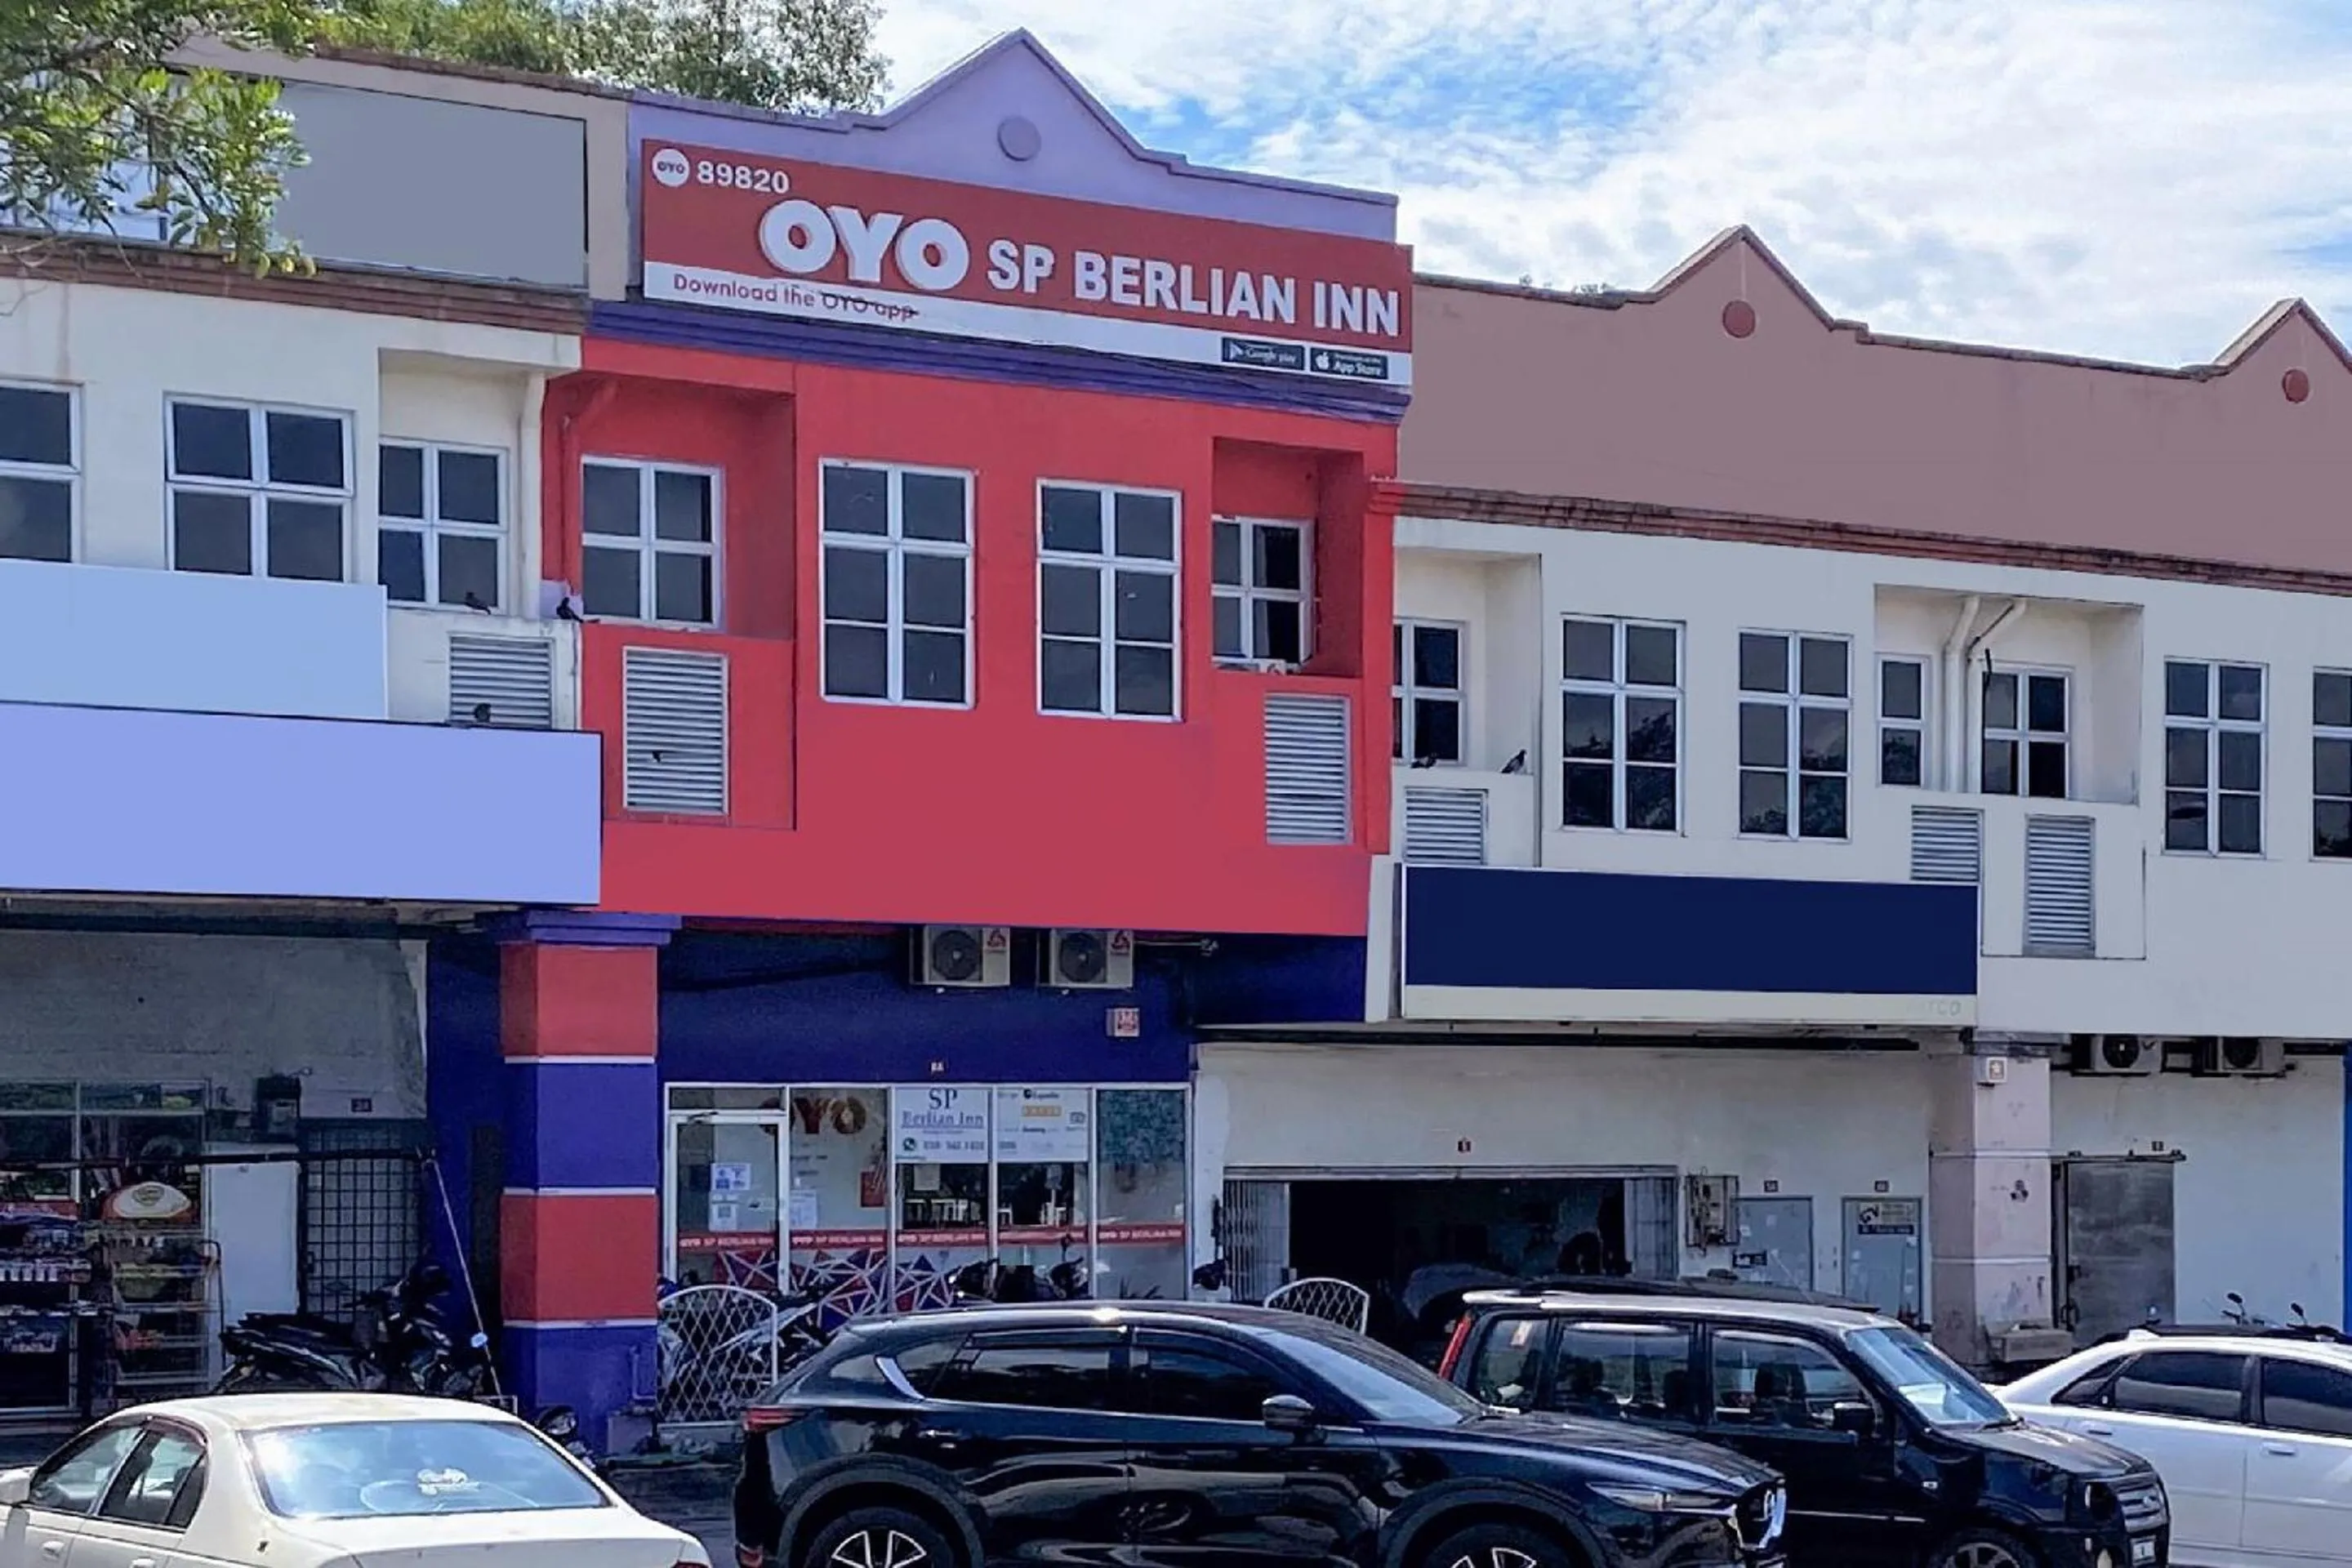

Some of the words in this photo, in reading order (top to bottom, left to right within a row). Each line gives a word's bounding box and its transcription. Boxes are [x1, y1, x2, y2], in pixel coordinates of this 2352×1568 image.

[697, 160, 790, 194] 89820
[760, 198, 970, 291] OYO
[987, 238, 1055, 294] SP
[1074, 249, 1295, 325] BERLIAN
[1313, 280, 1400, 337] INN
[673, 273, 777, 302] Download
[783, 287, 814, 307] the
[822, 293, 868, 313] OYO
[874, 301, 915, 323] app
[929, 1087, 958, 1110] SP
